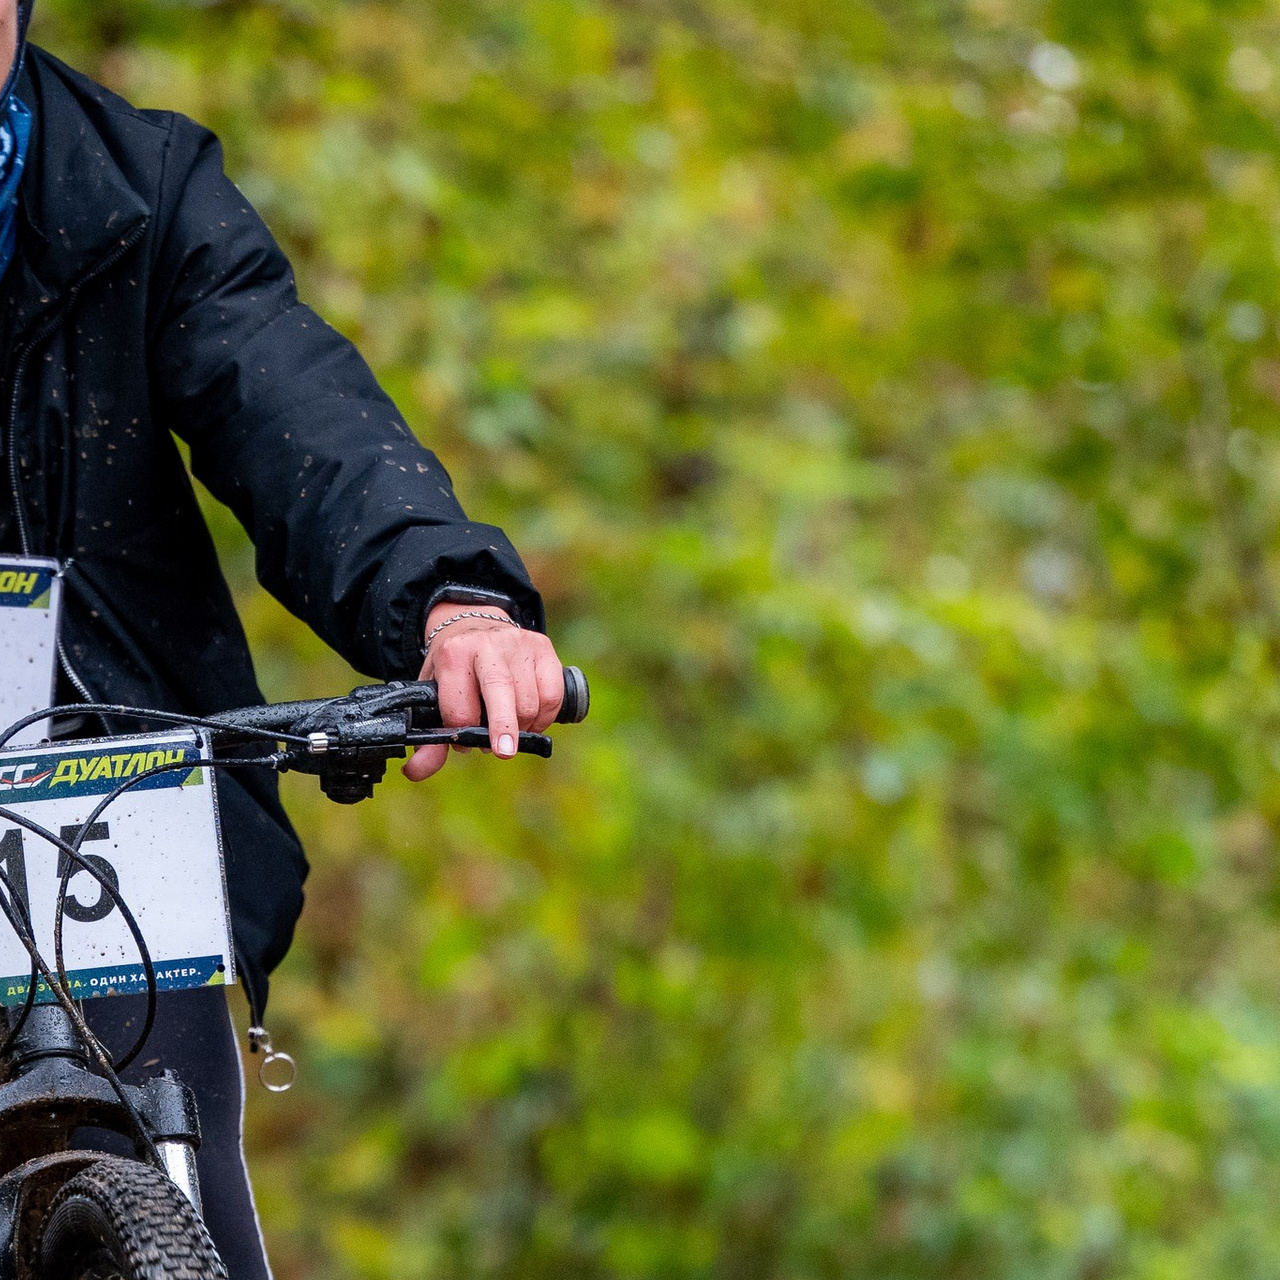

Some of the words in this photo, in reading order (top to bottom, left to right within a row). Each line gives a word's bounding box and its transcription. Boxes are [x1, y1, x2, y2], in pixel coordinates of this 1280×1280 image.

[48, 749, 184, 788] ДУАТЛОН
[90, 975, 126, 987] ОДИН
[130, 968, 202, 982] ХААКТЕР.
